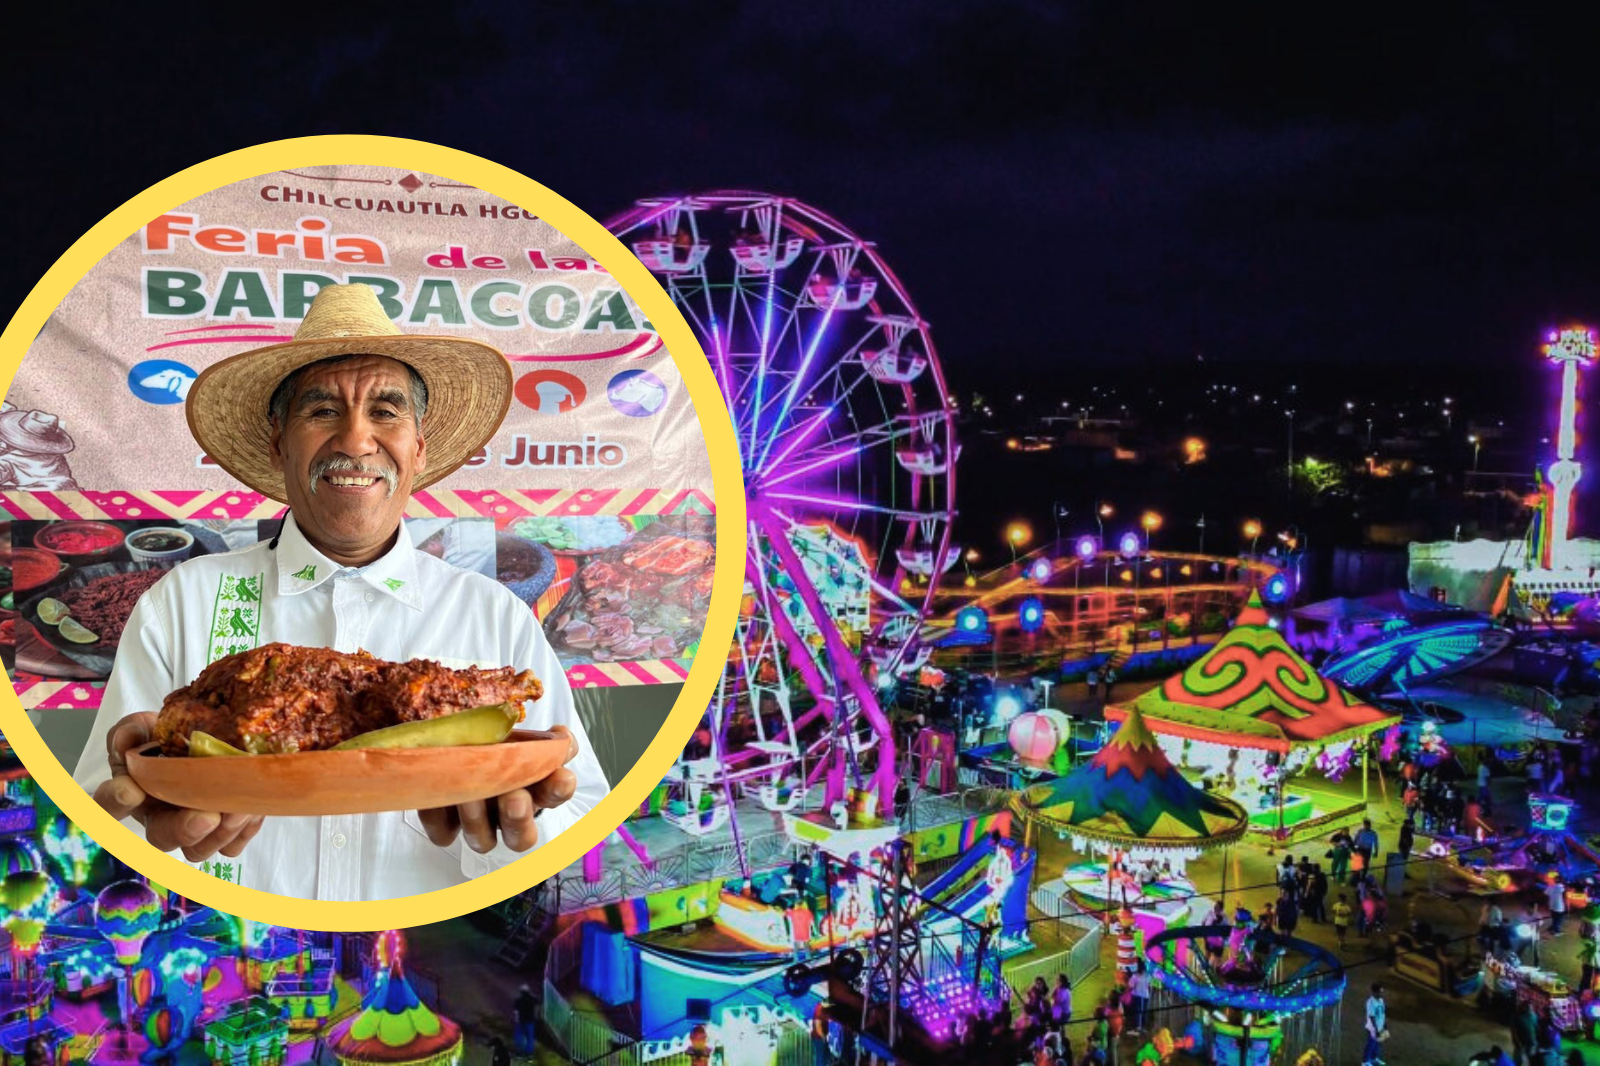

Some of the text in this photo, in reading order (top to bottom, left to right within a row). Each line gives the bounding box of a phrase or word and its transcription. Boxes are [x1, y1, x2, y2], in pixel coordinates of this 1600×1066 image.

[259, 185, 468, 217] CHILCUAUTLA
[146, 214, 385, 265] Feria
[426, 246, 507, 270] de
[147, 269, 657, 332] BARBACOA
[504, 436, 624, 466] Junio
